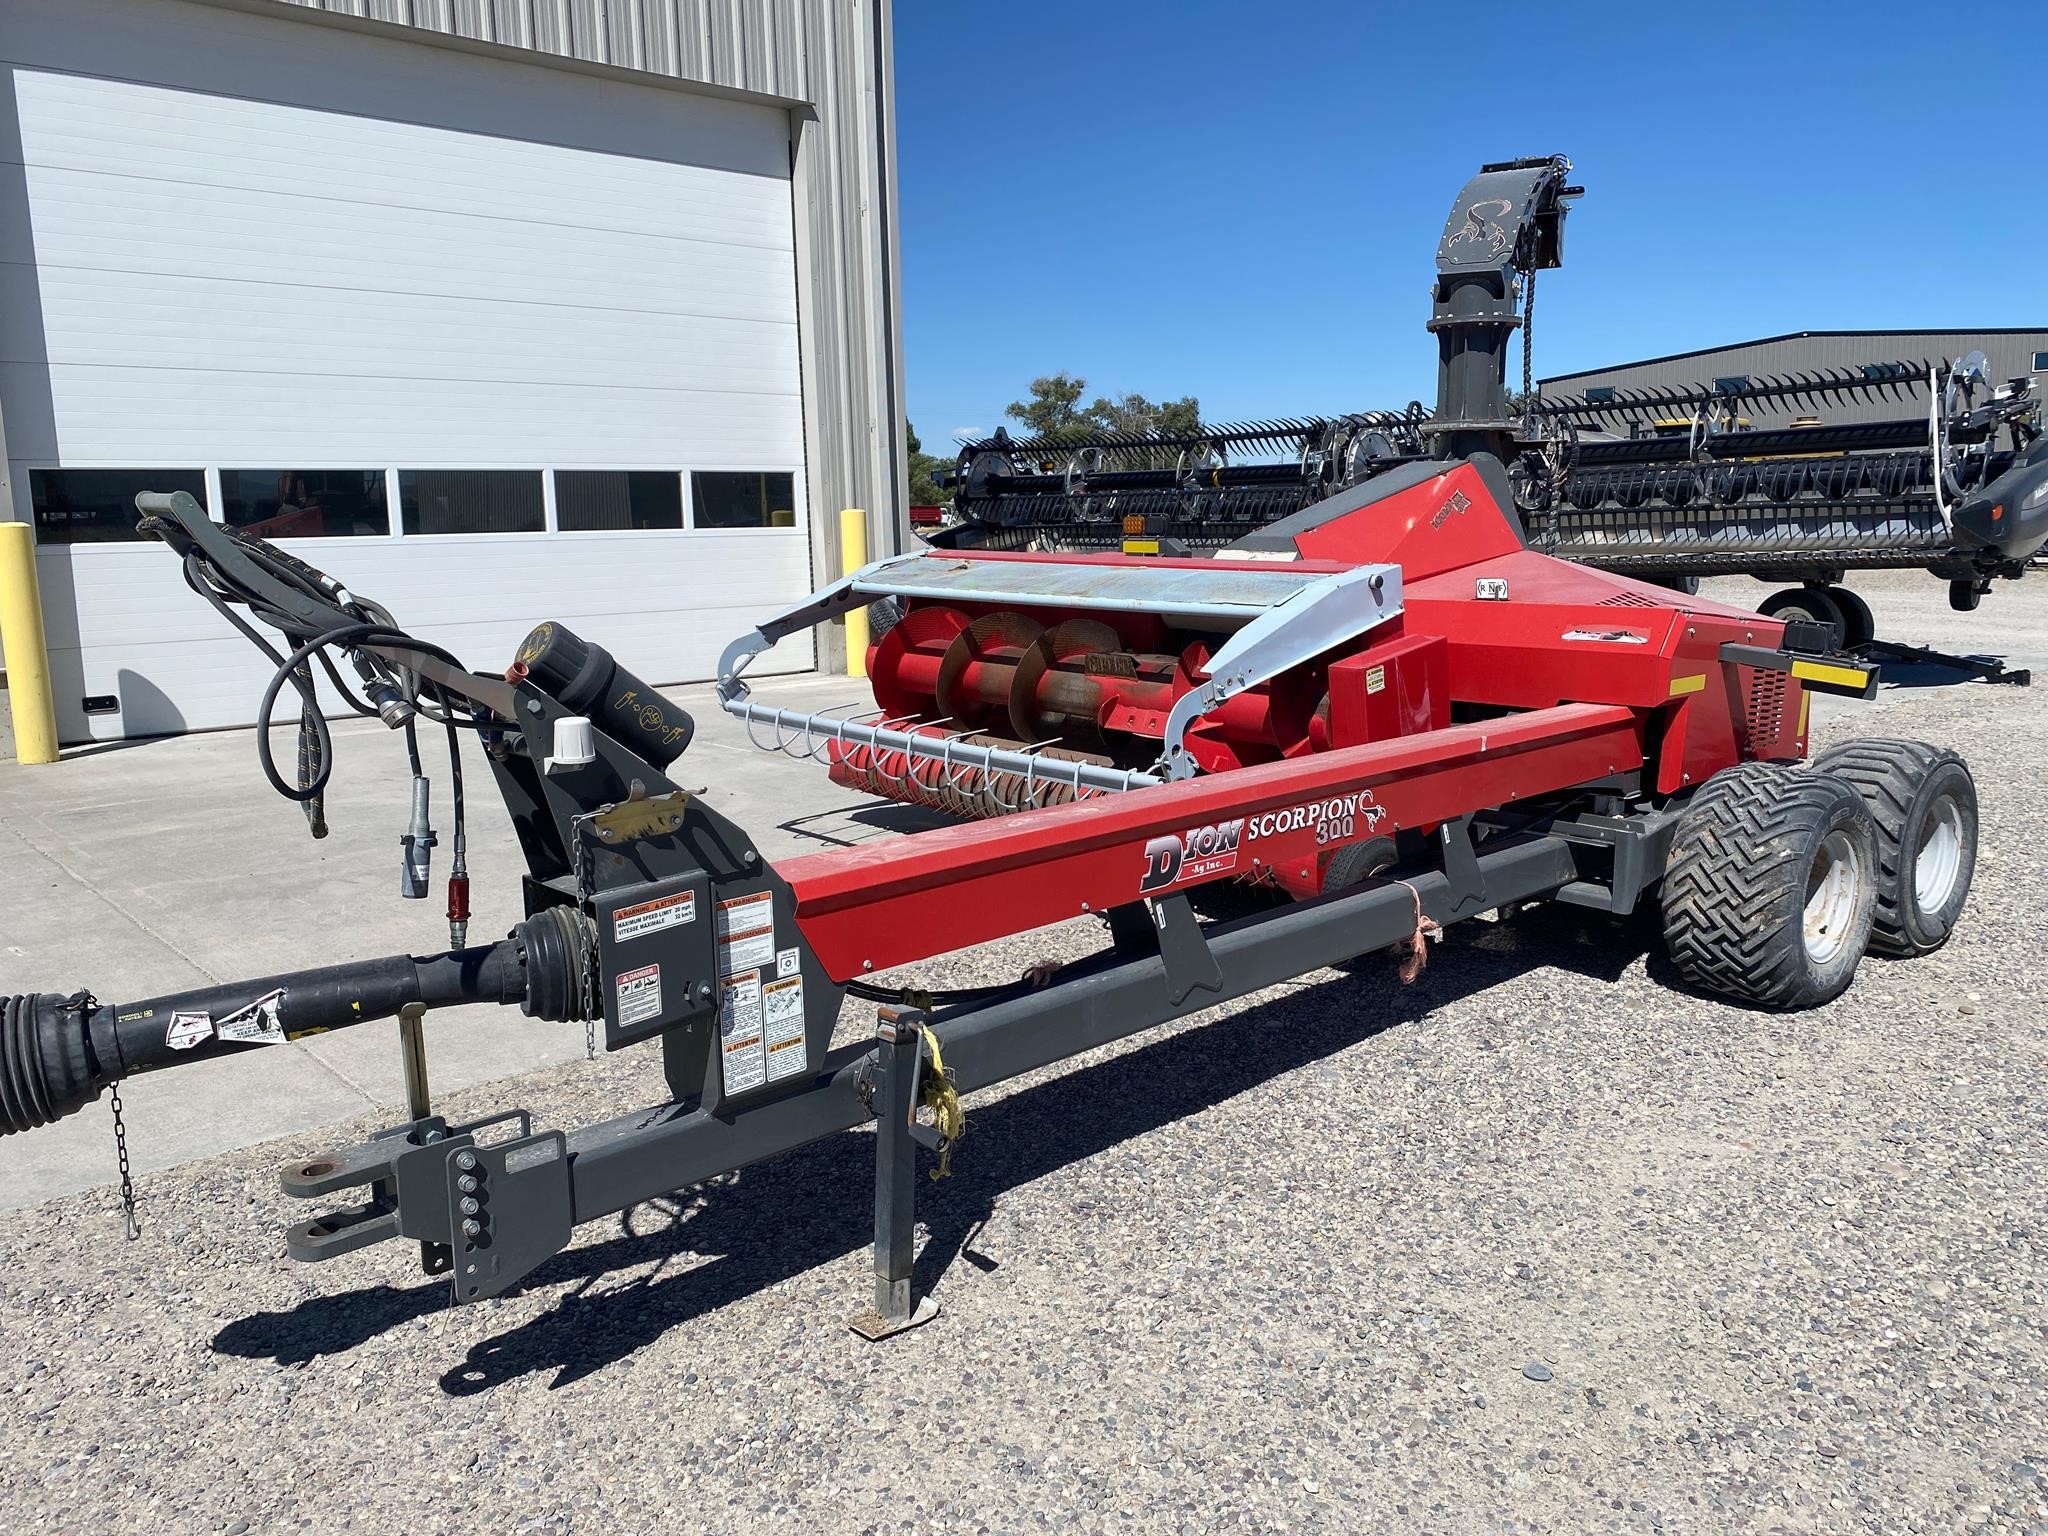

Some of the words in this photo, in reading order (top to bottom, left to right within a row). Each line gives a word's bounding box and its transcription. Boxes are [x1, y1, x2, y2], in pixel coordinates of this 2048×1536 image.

[1480, 584, 1486, 592] R
[1488, 584, 1496, 592] N
[1248, 794, 1359, 841] SCORPION
[1138, 818, 1244, 893] DION
[1206, 859, 1224, 871] Inc.
[623, 905, 650, 917] WARNING
[660, 894, 690, 907] ATTENTION
[733, 895, 761, 906] WARNING
[617, 918, 642, 929] MAXIMUM
[642, 912, 659, 922] SPEED
[658, 908, 673, 917] LIMIT
[681, 903, 692, 912] mph
[617, 925, 641, 936] VITESSE
[639, 918, 665, 930] MAXIMALE
[681, 910, 693, 919] km/h
[630, 968, 654, 980] DANGER
[731, 973, 754, 985] WARNING
[774, 979, 797, 990] WARNING
[733, 1037, 759, 1050] ATTENTION
[776, 1037, 801, 1050] ATTENTION
